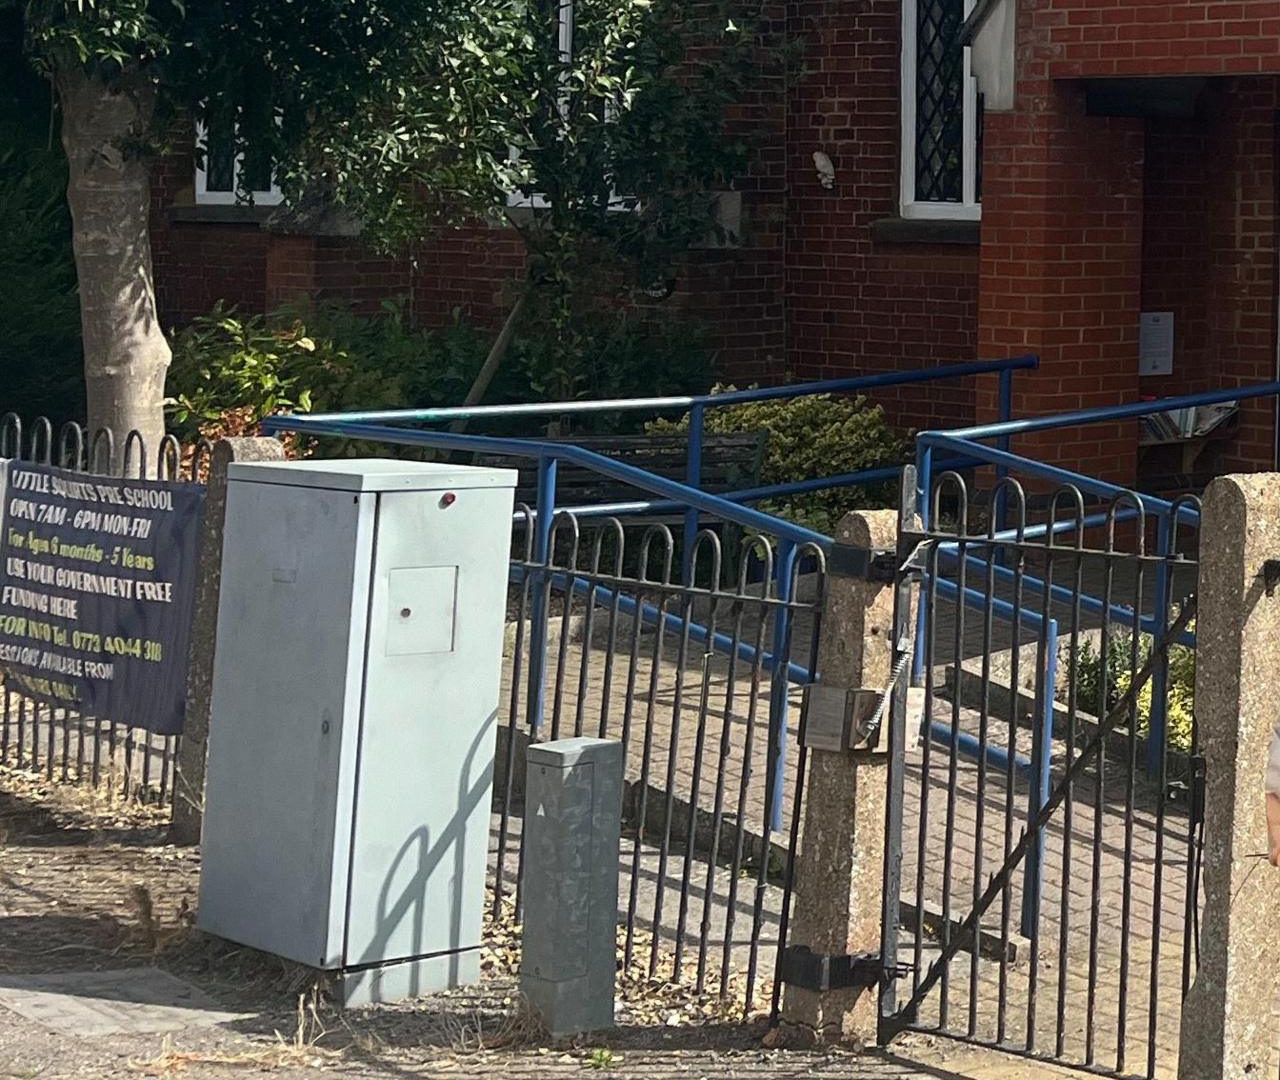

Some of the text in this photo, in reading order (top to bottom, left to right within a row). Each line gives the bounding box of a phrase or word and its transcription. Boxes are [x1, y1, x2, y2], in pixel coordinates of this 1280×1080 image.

[12, 470, 173, 511] LITTLE SQUIRTS PRE SCHOOL
[9, 498, 37, 520] OPEN
[37, 504, 67, 526] 7AM
[73, 510, 102, 532] 6PM
[101, 513, 152, 538] MON-FRI
[8, 527, 24, 547] For
[26, 530, 50, 554] Ages
[50, 536, 59, 554] 6
[59, 543, 104, 563] months
[110, 546, 121, 565] 5
[121, 547, 155, 570] Years
[6, 557, 172, 603] USE YOUR GOVERNMENT FREE
[2, 585, 78, 620] FUNDING HERE
[0, 615, 25, 637] FOR
[28, 619, 51, 642] INFO
[72, 630, 100, 653] 0773
[104, 636, 142, 658] 4044
[0, 643, 114, 680] ESSIONS AVAILABLE FROM
